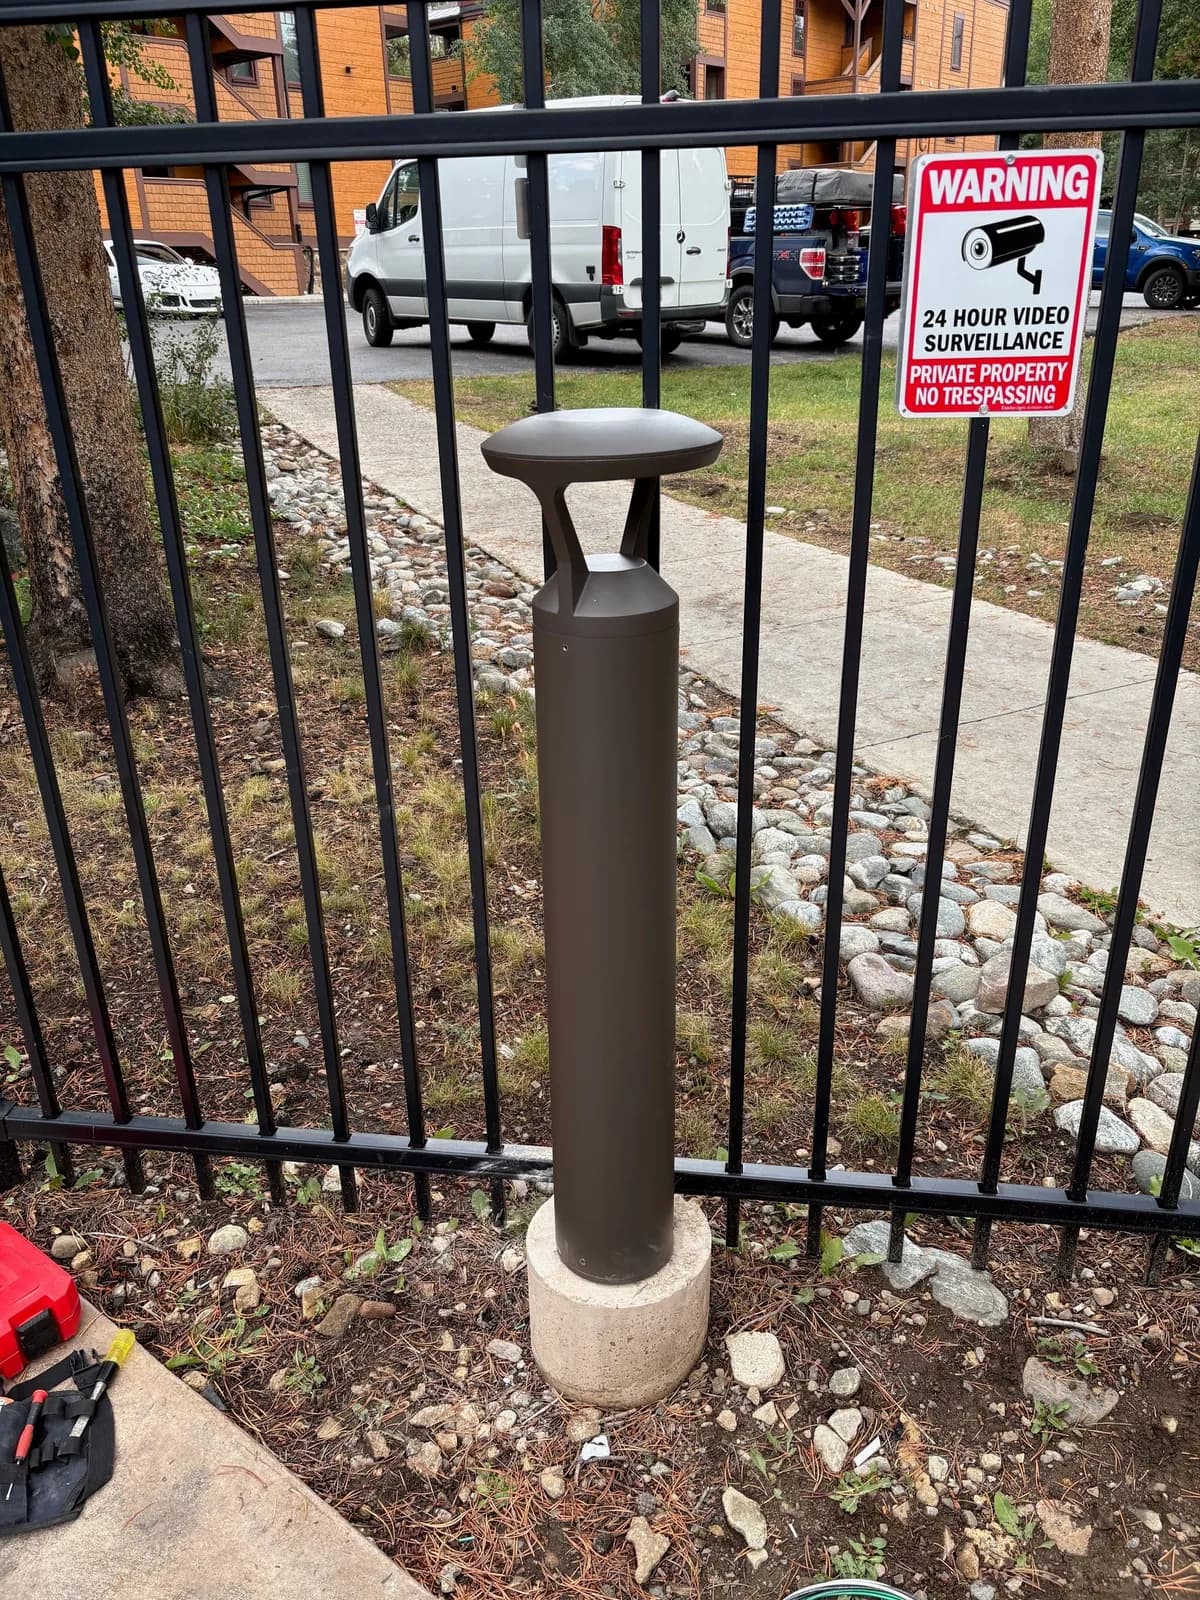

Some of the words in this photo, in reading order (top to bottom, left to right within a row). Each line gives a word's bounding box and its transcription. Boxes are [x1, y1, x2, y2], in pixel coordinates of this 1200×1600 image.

[929, 164, 1089, 205] WARNING
[923, 309, 947, 328] 24
[953, 307, 1007, 327] HOUR
[1013, 306, 1069, 325] VIDEO
[924, 331, 1064, 352] SURVEILLANCE
[910, 364, 976, 384] PRIVATE
[980, 362, 1068, 383] PROPERTY
[915, 386, 939, 405] NO
[942, 385, 1056, 405] TRESPASSING
